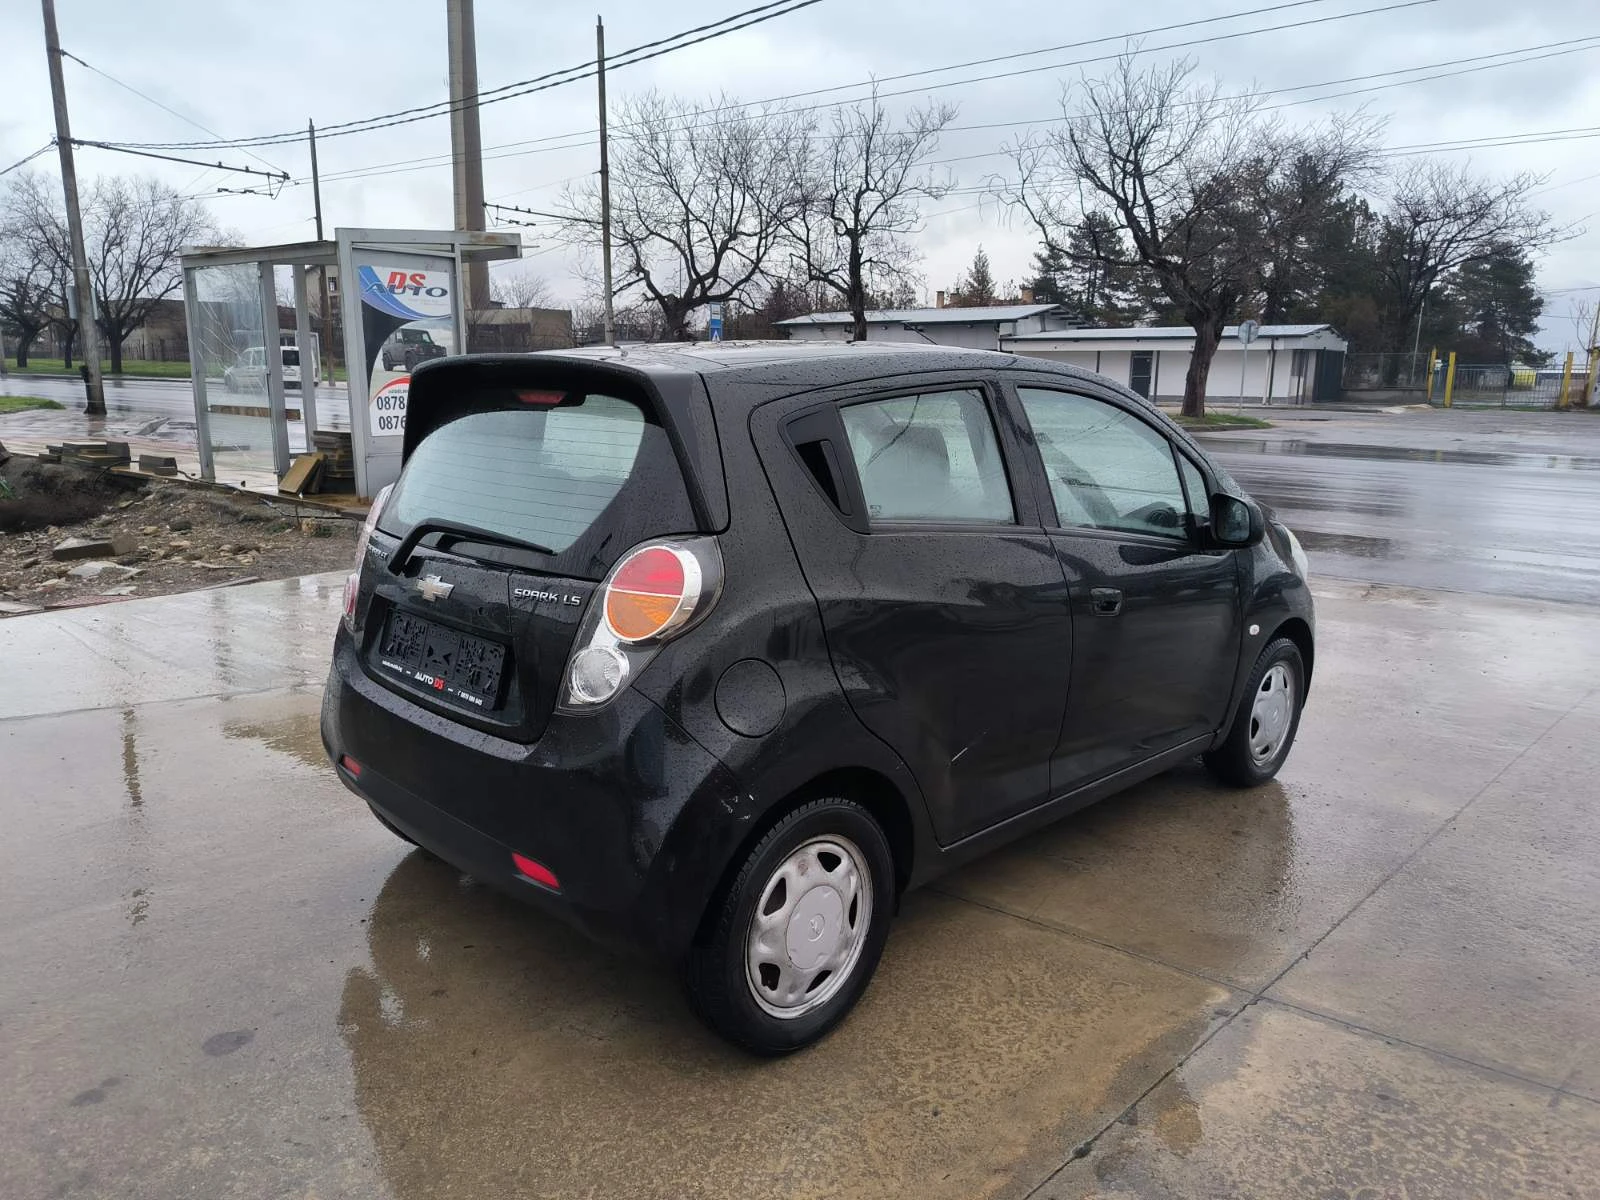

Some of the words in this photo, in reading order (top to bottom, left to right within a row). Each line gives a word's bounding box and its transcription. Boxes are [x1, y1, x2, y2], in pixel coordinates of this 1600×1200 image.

[387, 271, 426, 289] DS
[366, 282, 448, 297] AUTO
[376, 395, 406, 410] 0878
[514, 588, 560, 602] SPARK
[563, 594, 581, 606] LS
[414, 671, 434, 685] AUTO
